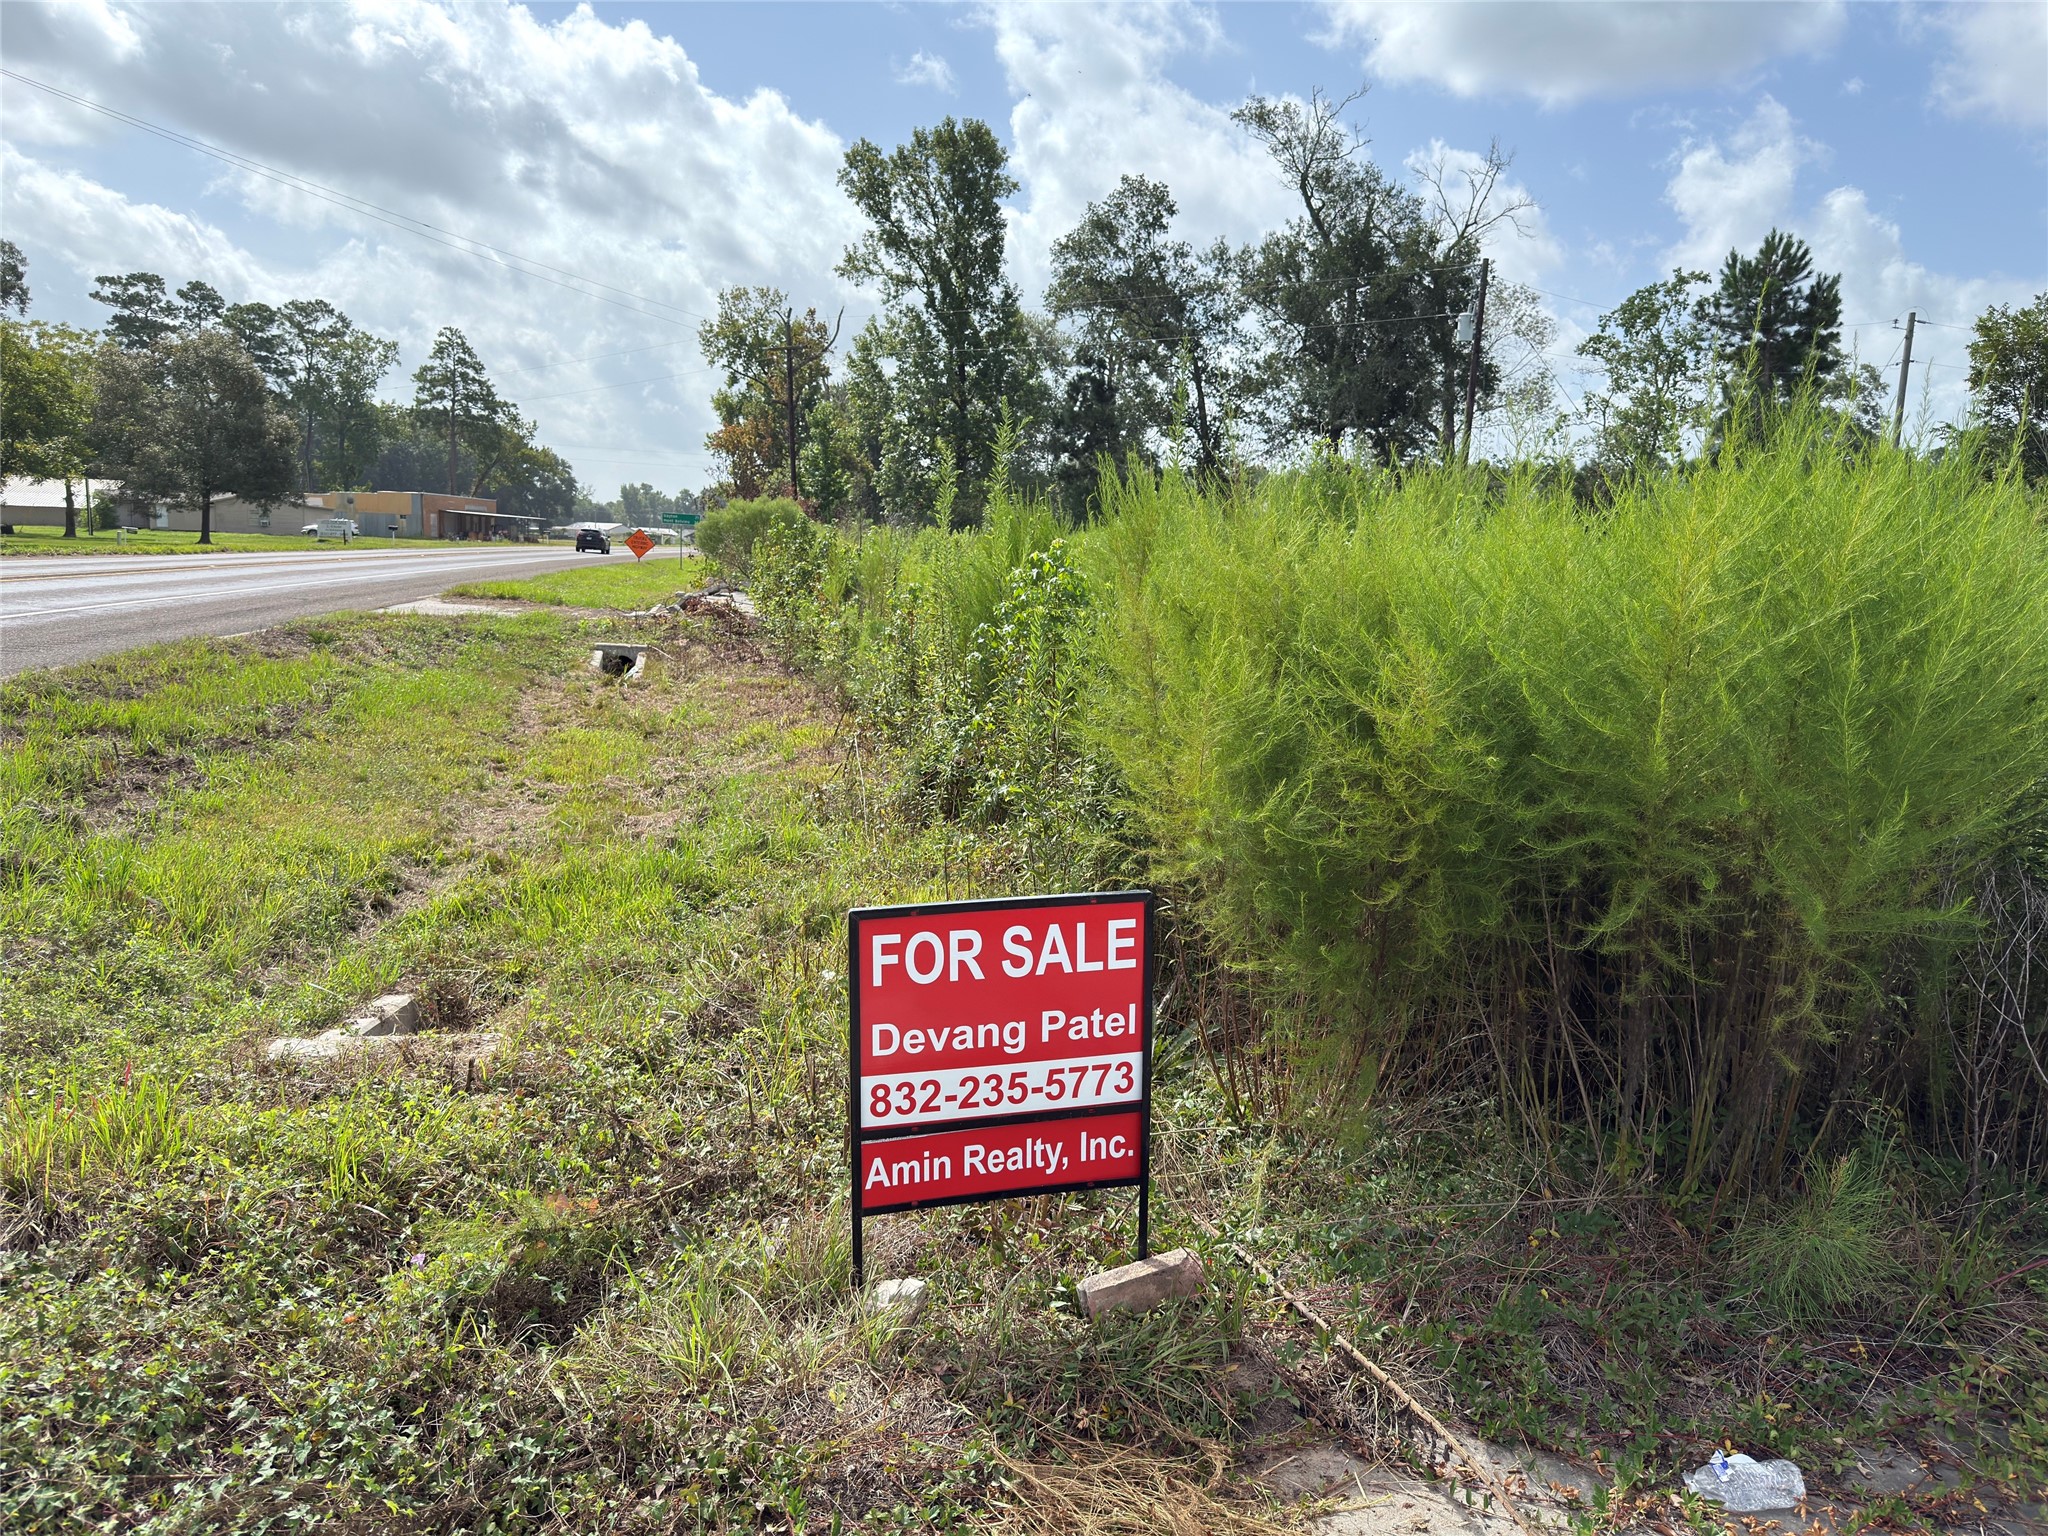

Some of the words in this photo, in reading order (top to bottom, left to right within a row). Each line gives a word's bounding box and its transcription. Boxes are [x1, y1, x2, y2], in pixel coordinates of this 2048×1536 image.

[871, 929, 986, 987] FOR
[1001, 918, 1137, 978] SALE
[871, 1020, 1026, 1057] Devang
[1041, 1003, 1136, 1043] Patel
[869, 1060, 1135, 1118] 832-235-5773
[864, 1149, 951, 1190] Amin
[963, 1136, 1068, 1177] Realty,
[1080, 1131, 1135, 1162] Inc.
